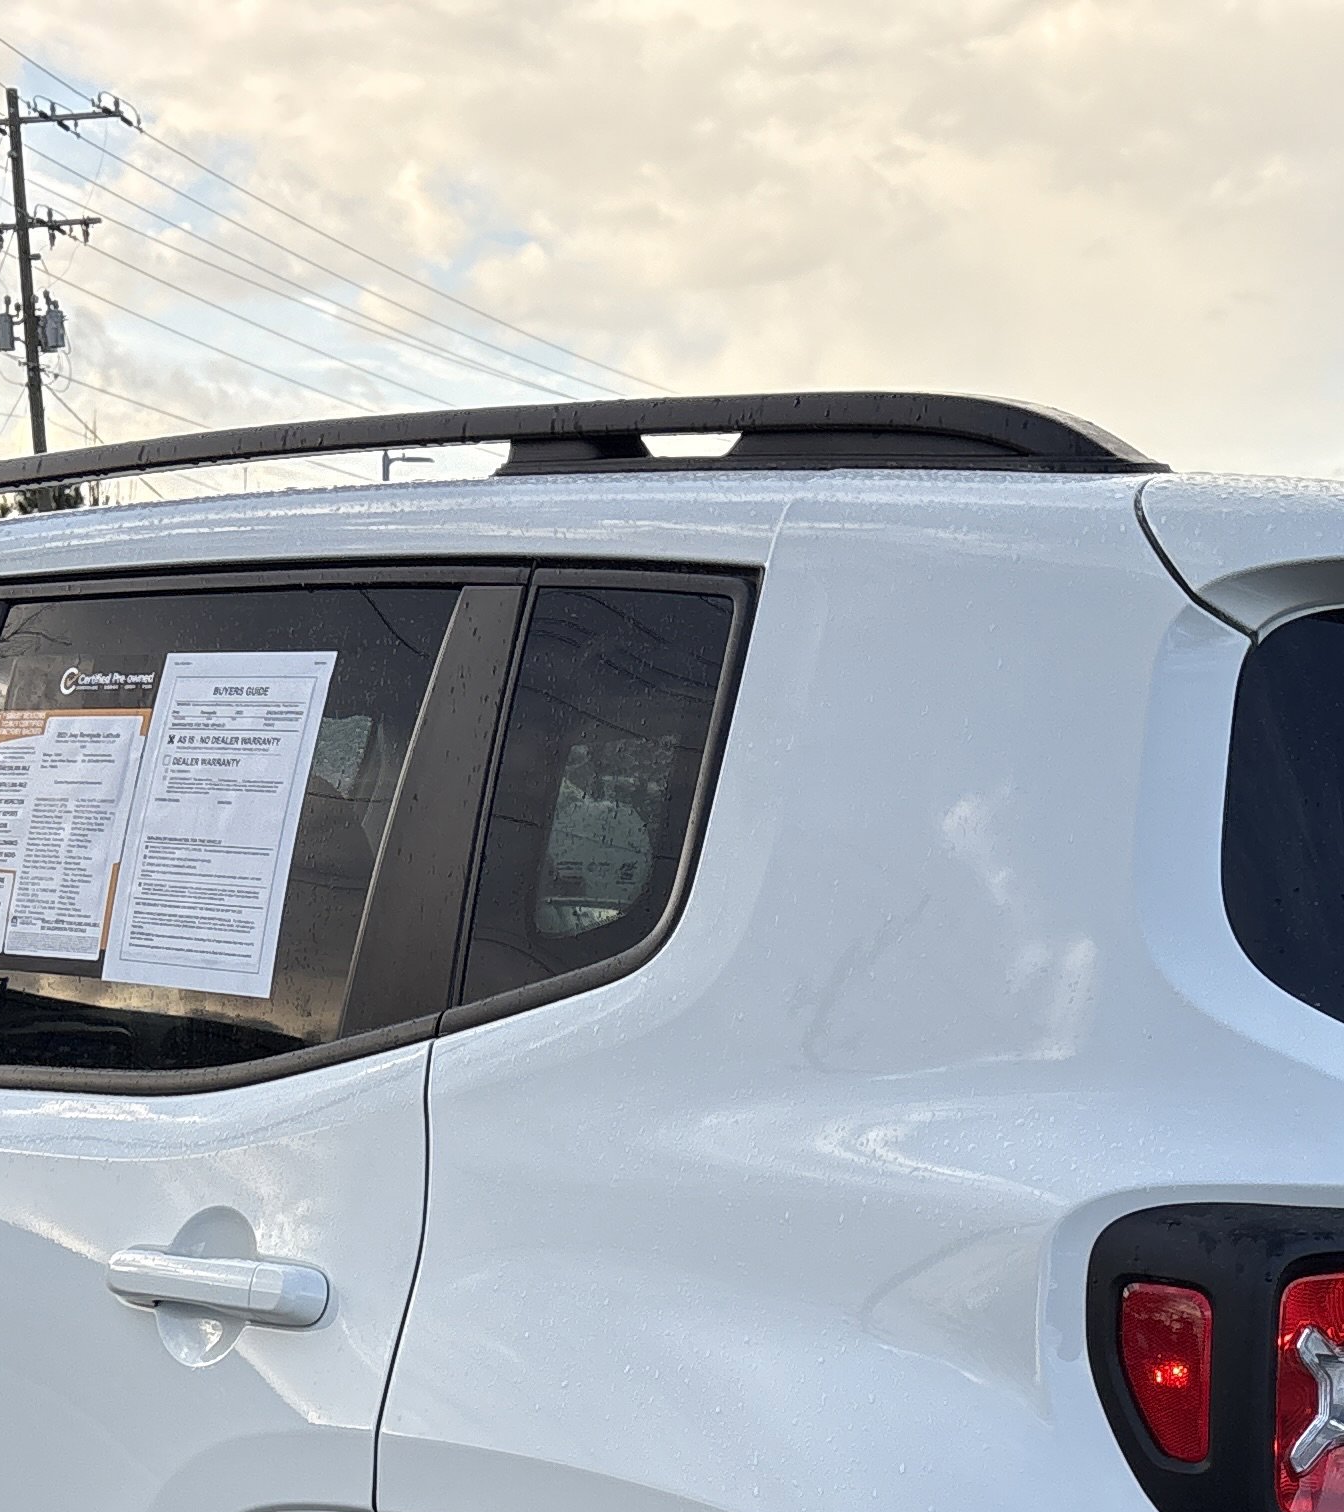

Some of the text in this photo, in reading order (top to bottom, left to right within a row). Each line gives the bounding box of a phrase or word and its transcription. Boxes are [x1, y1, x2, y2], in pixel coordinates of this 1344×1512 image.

[78, 672, 111, 685] Certified
[213, 686, 270, 697] BUYERS GUIDE
[177, 736, 282, 747] AS IS NO DEALER WARRANTY
[172, 757, 242, 768] DEALER WARRANTY
